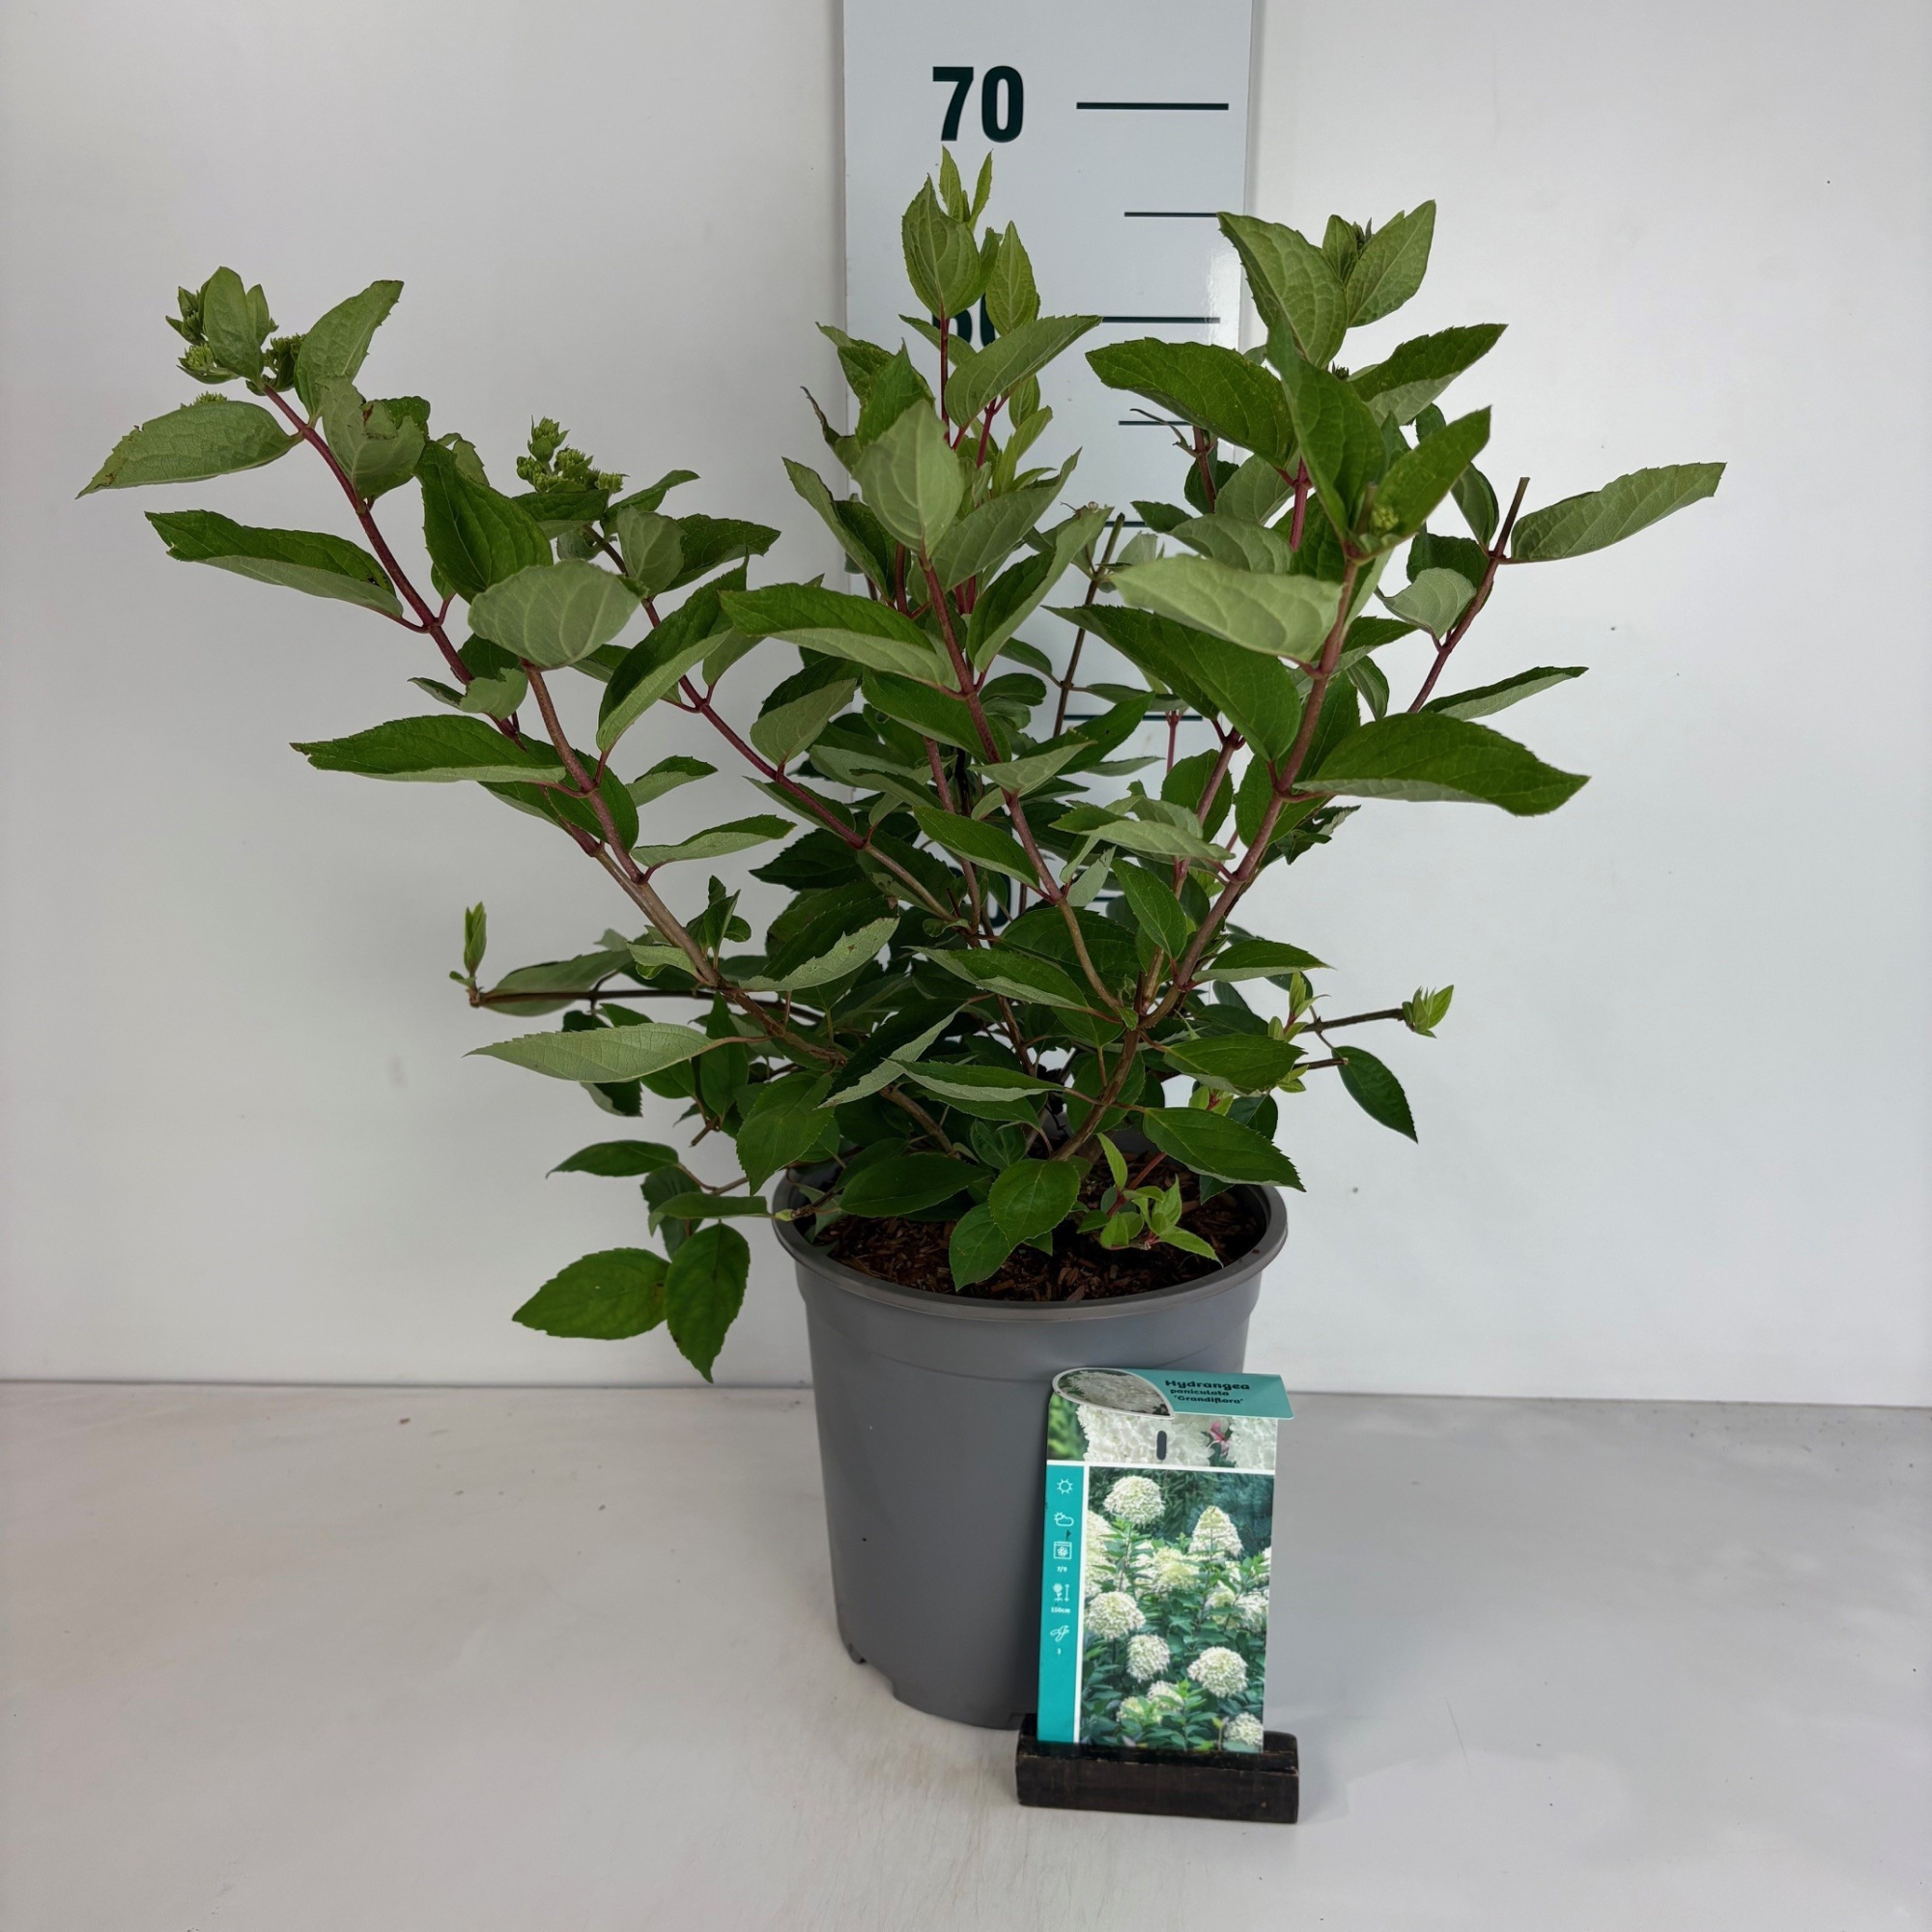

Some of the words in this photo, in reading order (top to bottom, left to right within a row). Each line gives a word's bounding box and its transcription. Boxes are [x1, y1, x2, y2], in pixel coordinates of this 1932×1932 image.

[932, 66, 1024, 143] 70
[1165, 1379, 1250, 1391] Hydrangea
[1170, 1388, 1230, 1397] paniculata
